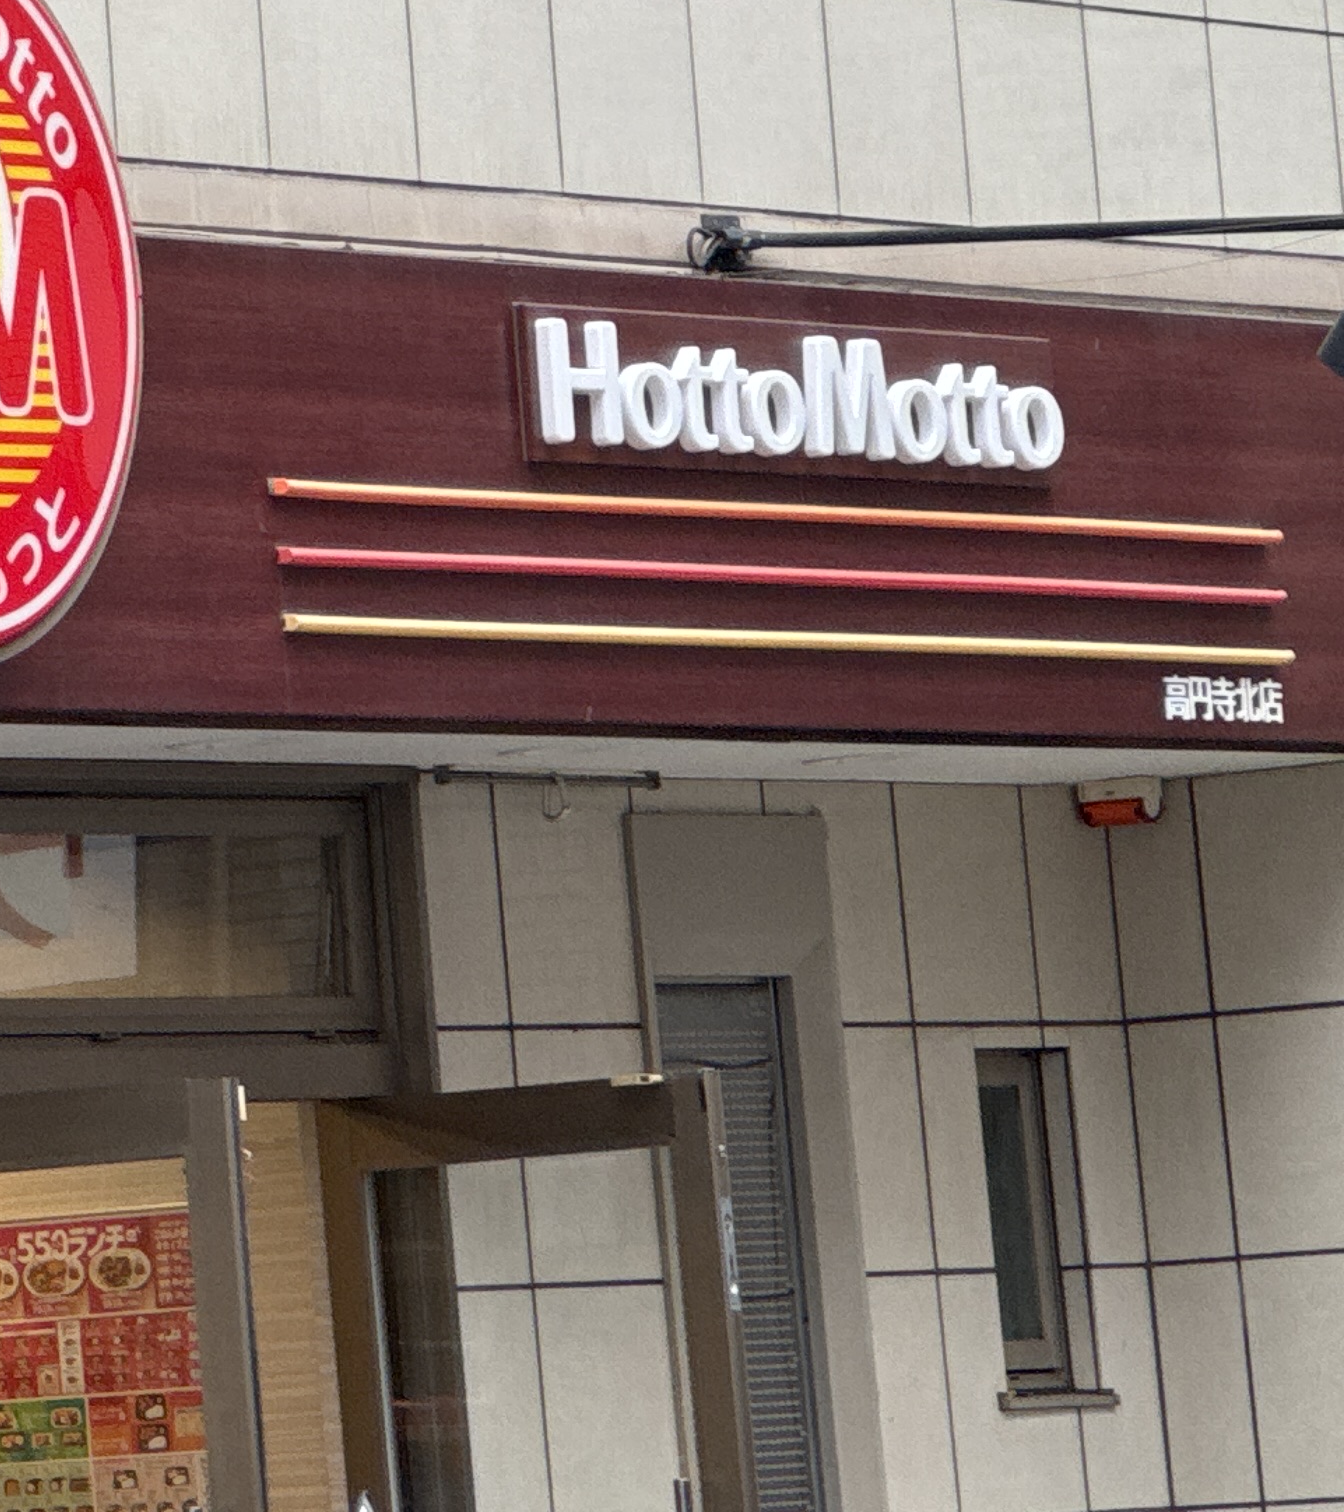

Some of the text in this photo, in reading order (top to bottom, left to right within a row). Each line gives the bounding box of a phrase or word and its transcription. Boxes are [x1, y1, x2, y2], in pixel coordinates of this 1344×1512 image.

[1162, 674, 1285, 724] 高円寺北店
